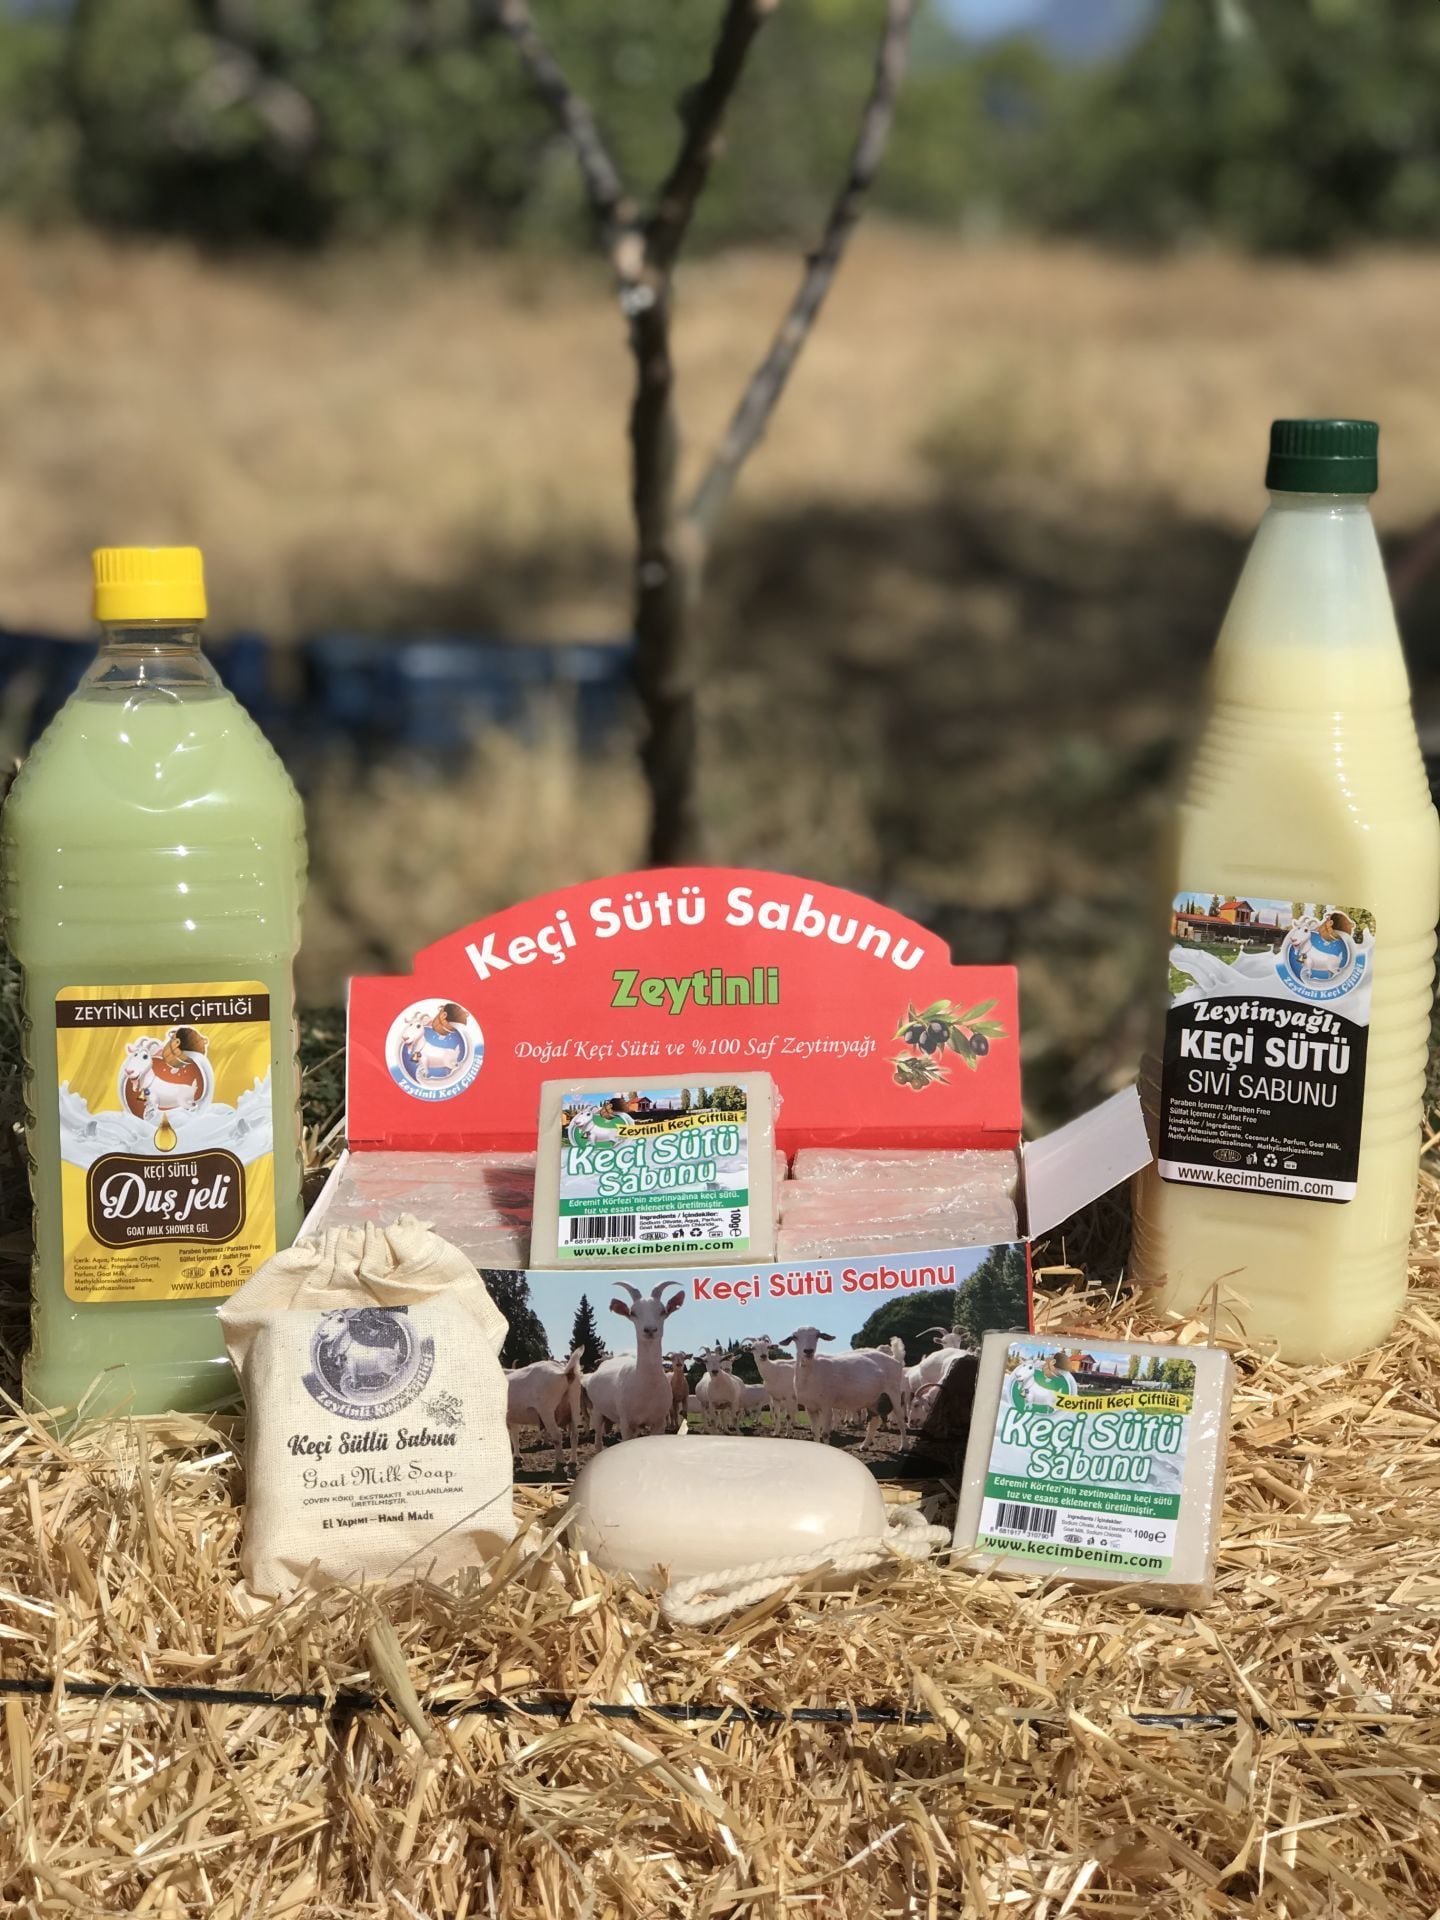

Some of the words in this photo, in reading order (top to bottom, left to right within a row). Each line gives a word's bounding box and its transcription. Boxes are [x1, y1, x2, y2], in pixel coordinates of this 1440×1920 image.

[464, 909, 577, 981] Keçi
[590, 886, 706, 938] Sütü
[725, 887, 925, 971] Sabunu
[611, 966, 780, 1015] Zeytinli
[1284, 977, 1318, 998] Zeytinli
[1320, 987, 1341, 999] Keçi
[74, 1002, 143, 1021] ZEYTİNLİ
[149, 1001, 184, 1022] KEÇİ
[190, 998, 252, 1021] ÇİFTLİĞİ
[1193, 1000, 1341, 1035] Zeytinyağlı
[514, 1039, 572, 1064] Doğal
[573, 1039, 614, 1061] Keçi
[617, 1039, 660, 1057] Sütü
[665, 1043, 686, 1056] ve
[692, 1038, 741, 1055] %100
[744, 1035, 780, 1060] Saf
[781, 1035, 876, 1059] Zeytinyağı
[1180, 1027, 1254, 1071] KEÇİ
[1264, 1032, 1351, 1075] SÜTÜ
[399, 1078, 436, 1099] Zeytinli
[440, 1086, 461, 1098] Keçi
[1188, 1069, 1231, 1096] SIVI
[1238, 1074, 1338, 1108] SABUNU
[1170, 1098, 1197, 1107] Paraben
[1198, 1100, 1224, 1110] İçermez
[1256, 1107, 1271, 1116] Free
[1190, 1108, 1216, 1119] İçermez
[1222, 1113, 1241, 1122] Sulfat
[1242, 1115, 1258, 1124] Free
[618, 1124, 664, 1137] Zeytinli
[668, 1119, 694, 1133] Keçi
[697, 1112, 738, 1126] Çiftliği
[567, 1138, 646, 1176] Keçi
[652, 1125, 740, 1164] Sütü
[143, 1162, 165, 1181] KEÇİ
[167, 1161, 198, 1178] SÜTLÜ
[598, 1160, 717, 1197] Sabunu
[1178, 1166, 1334, 1196] www.kecimbenim.com
[99, 1172, 178, 1220] Duş
[174, 1174, 231, 1221] jeli
[584, 1207, 597, 1215] tuz
[636, 1202, 675, 1212] eklenerek
[126, 1226, 145, 1237] GOAT
[147, 1225, 164, 1236] MILK
[165, 1224, 195, 1235] SHOWER
[196, 1223, 209, 1233] GEL
[573, 1241, 734, 1257] www.kecimbenim.com
[693, 1275, 760, 1306] Keçi
[769, 1270, 833, 1298] Sütü
[841, 1264, 955, 1293] Sabunu
[1056, 1395, 1103, 1411] Zeytinli
[1107, 1396, 1134, 1409] Keçi
[1138, 1393, 1180, 1408] Çiftliği
[287, 1434, 332, 1462] Keçi
[338, 1431, 389, 1455] Sütlü
[396, 1427, 458, 1450] Sabun
[1001, 1407, 1088, 1452] Keçi
[1088, 1411, 1184, 1454] Sütü
[302, 1467, 345, 1489] Goat
[351, 1466, 404, 1486] Milk
[407, 1460, 455, 1484] Soap
[1027, 1448, 1151, 1482] Sabunu
[993, 1476, 1029, 1489] Edremit
[1133, 1494, 1152, 1505] keçi
[1006, 1490, 1020, 1499] tuz
[1021, 1492, 1033, 1501] ve
[1034, 1494, 1059, 1504] esans
[1060, 1497, 1103, 1510] eklenerek
[984, 1536, 1163, 1570] www.kecimbenim.com
